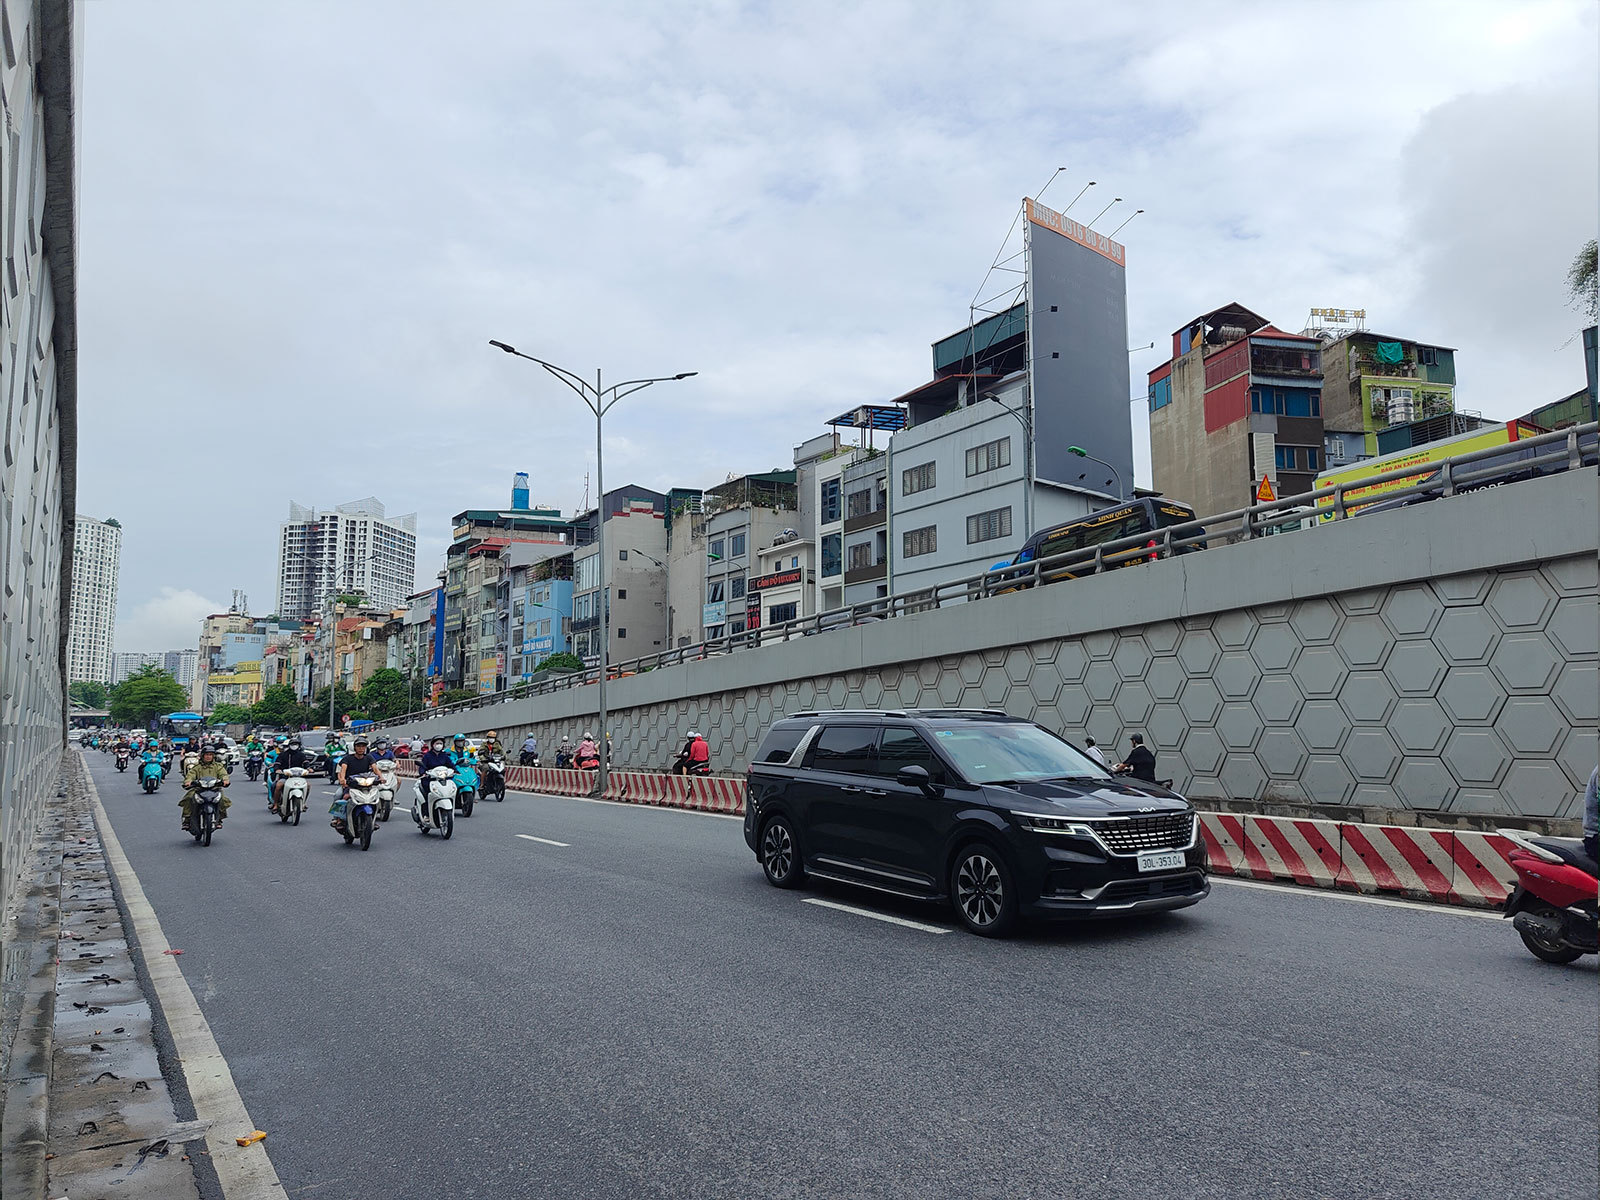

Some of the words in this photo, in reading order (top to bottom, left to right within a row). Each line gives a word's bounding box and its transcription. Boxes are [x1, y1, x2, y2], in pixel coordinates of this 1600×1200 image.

[1061, 215, 1083, 240] 0916
[1098, 233, 1109, 253] 20
[1111, 240, 1122, 260] 99
[1403, 457, 1430, 468] EXPRESS
[1097, 512, 1114, 522] MINH
[1142, 855, 1182, 869] 30L-353.04
